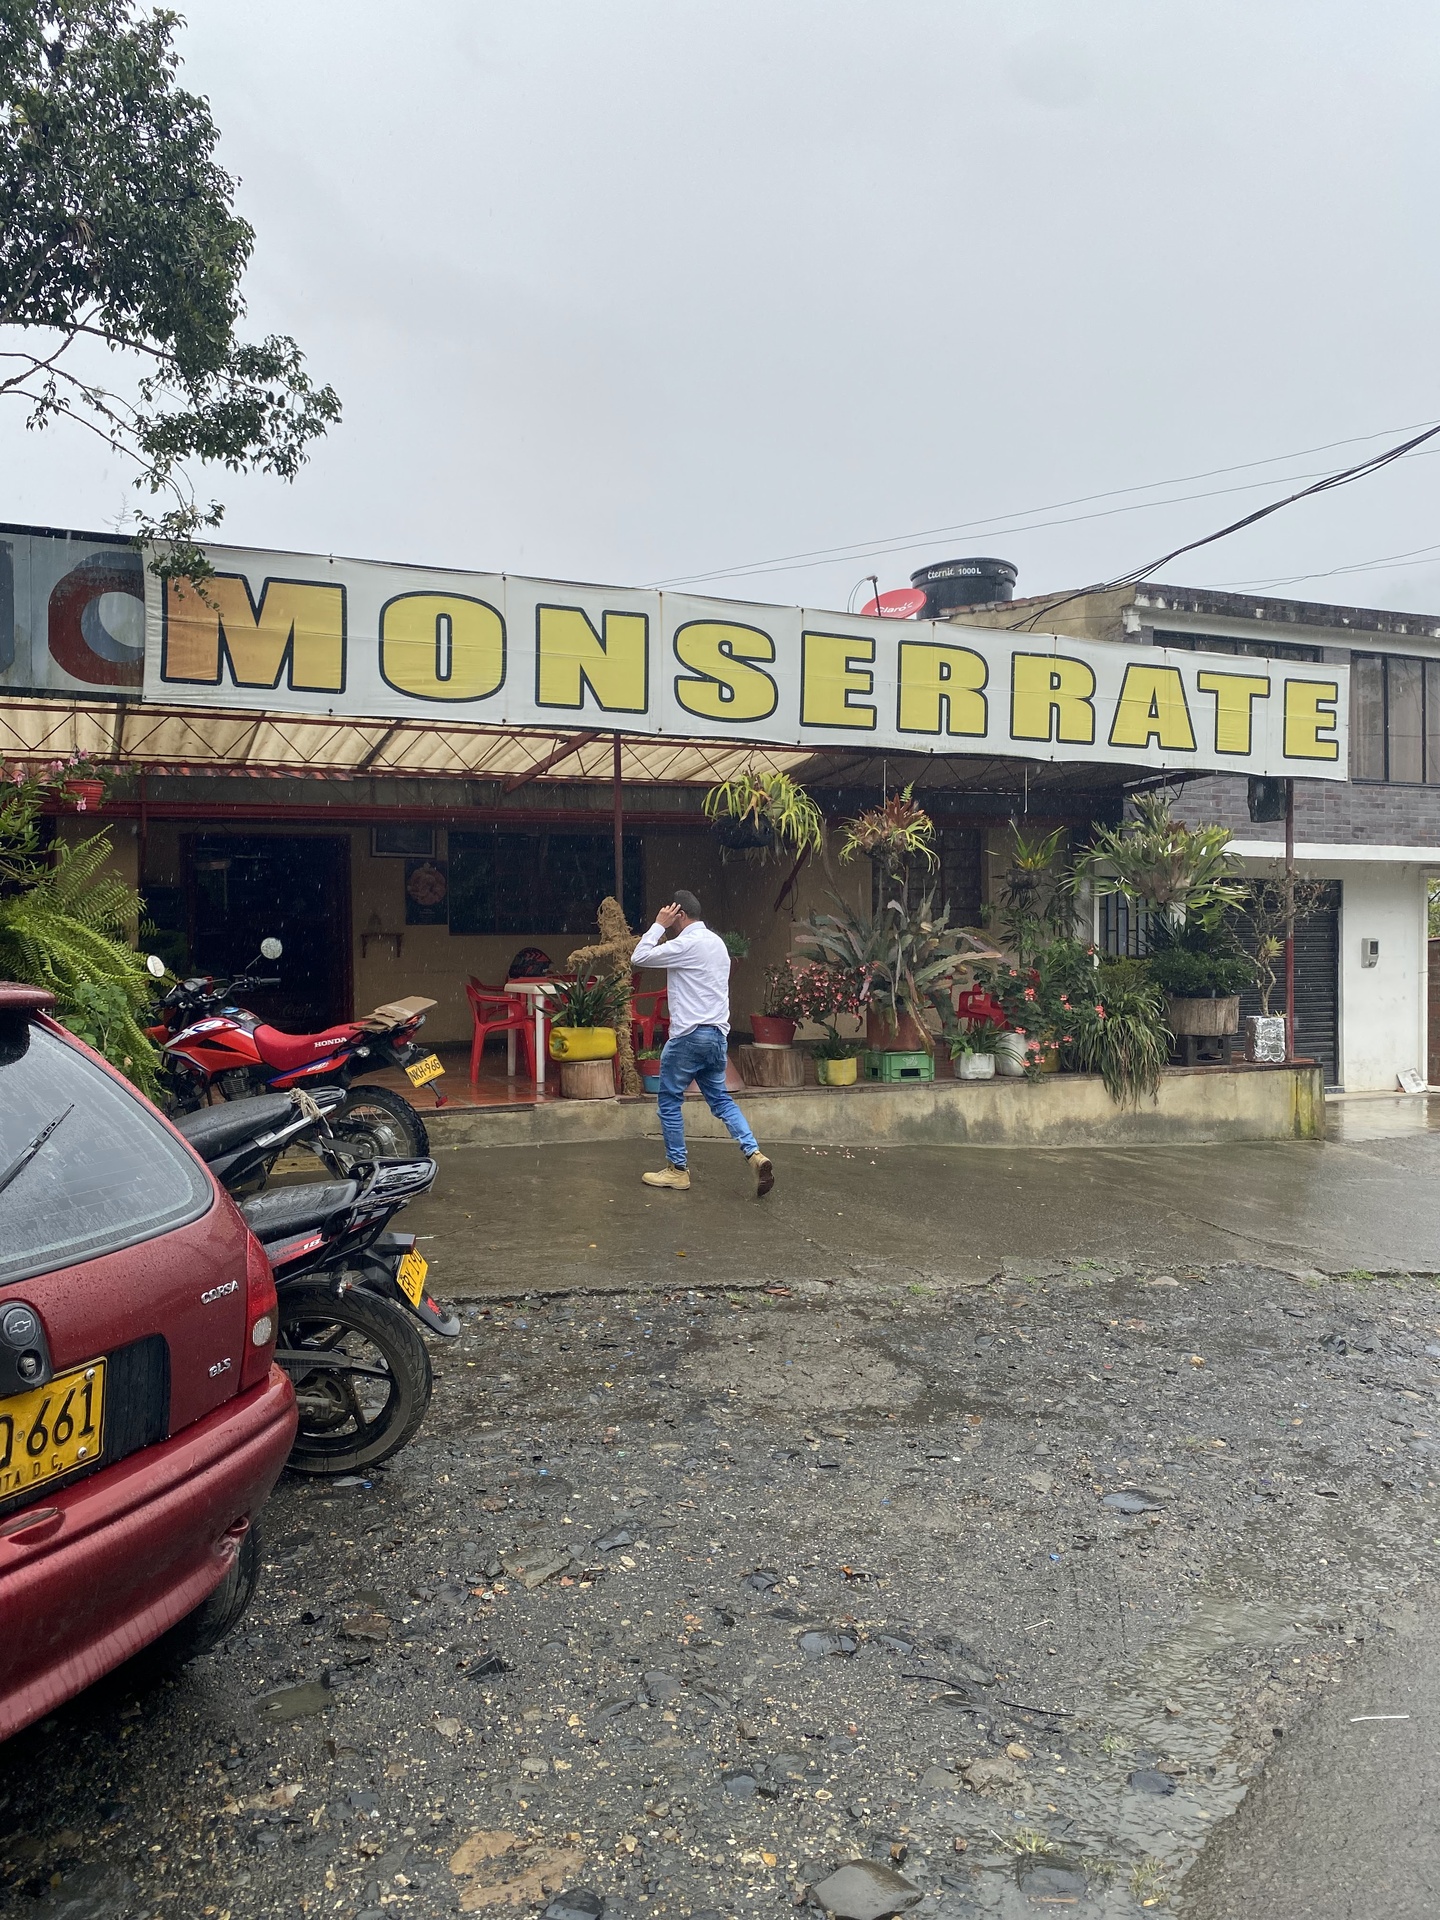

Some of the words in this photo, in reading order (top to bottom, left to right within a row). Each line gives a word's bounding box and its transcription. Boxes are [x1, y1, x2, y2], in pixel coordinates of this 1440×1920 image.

[874, 603, 907, 614] Claro
[160, 571, 1340, 761] MONSERRATE
[313, 1036, 348, 1048] HONDA
[200, 1278, 239, 1305] CORSA
